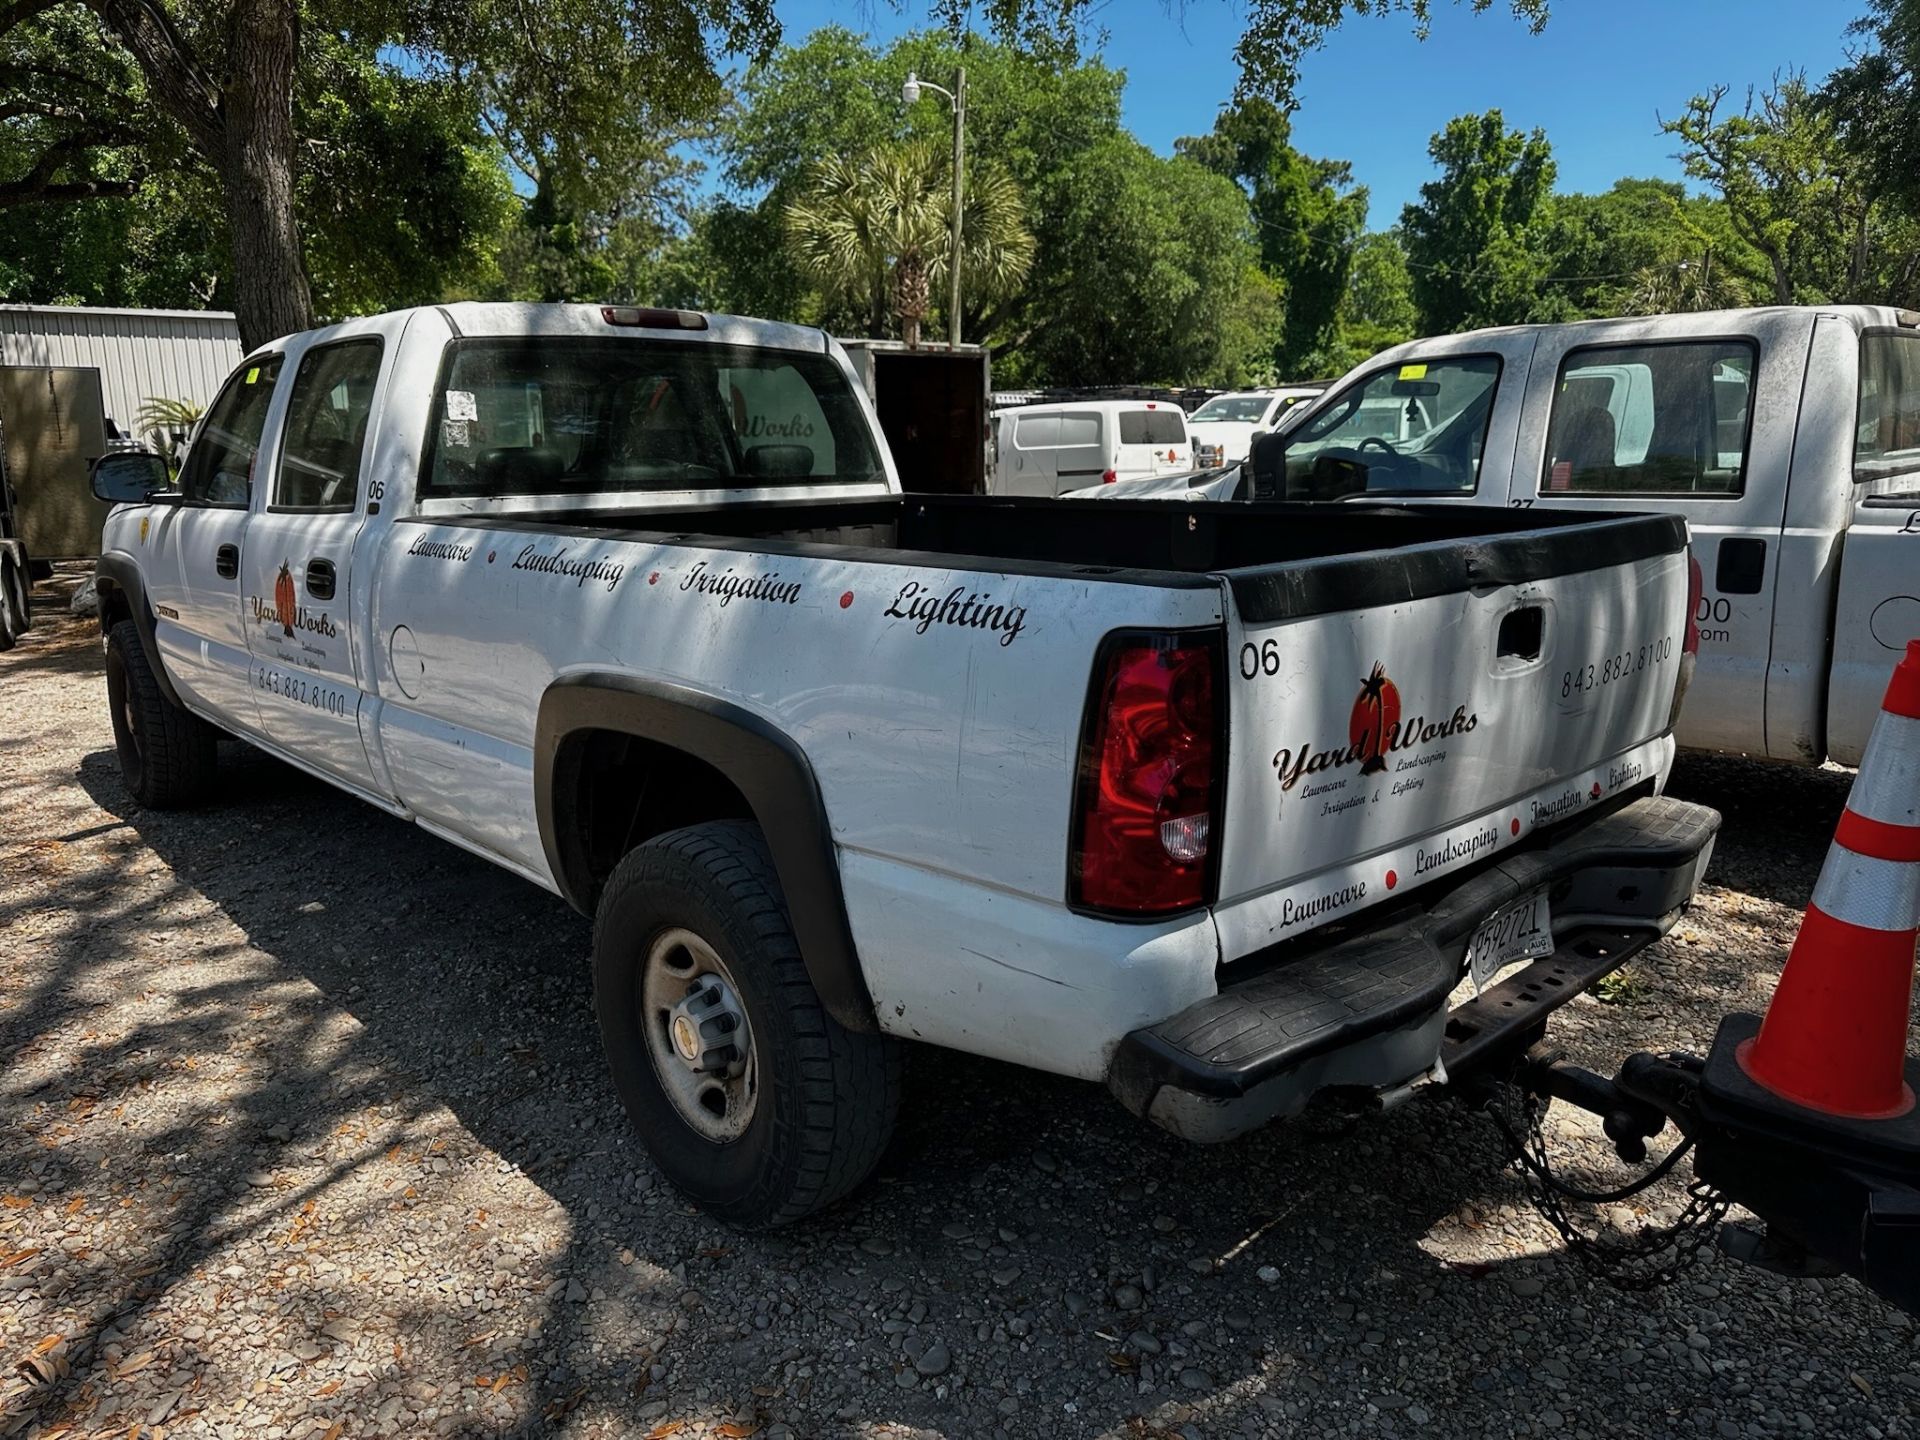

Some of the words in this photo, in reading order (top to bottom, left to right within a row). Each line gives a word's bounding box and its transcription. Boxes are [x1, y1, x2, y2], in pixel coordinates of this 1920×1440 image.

[741, 413, 816, 438] Works
[369, 480, 385, 500] 06
[407, 532, 473, 562] Lawncare
[511, 543, 625, 592] Landscaping
[680, 561, 802, 608] Irrigation
[884, 581, 1027, 647] Lighting
[251, 595, 286, 624] Yard
[294, 607, 337, 639] Works
[1697, 629, 1729, 642] om
[1240, 638, 1281, 681] 06
[1561, 636, 1672, 698] 843.882.8100
[258, 668, 345, 717] 843.882.8100
[1272, 728, 1371, 792] Yard
[1386, 704, 1478, 753] Works
[1300, 778, 1347, 800] Lawncare
[1395, 751, 1447, 772] Landscaping
[1320, 795, 1367, 816] Irrigation
[1391, 777, 1425, 796] Lighting
[1280, 879, 1368, 929] Lawncare
[1414, 825, 1499, 877] Landscaping
[1608, 762, 1642, 789] Lighting
[1475, 900, 1541, 968] P592721
[1530, 939, 1547, 950] AUG
